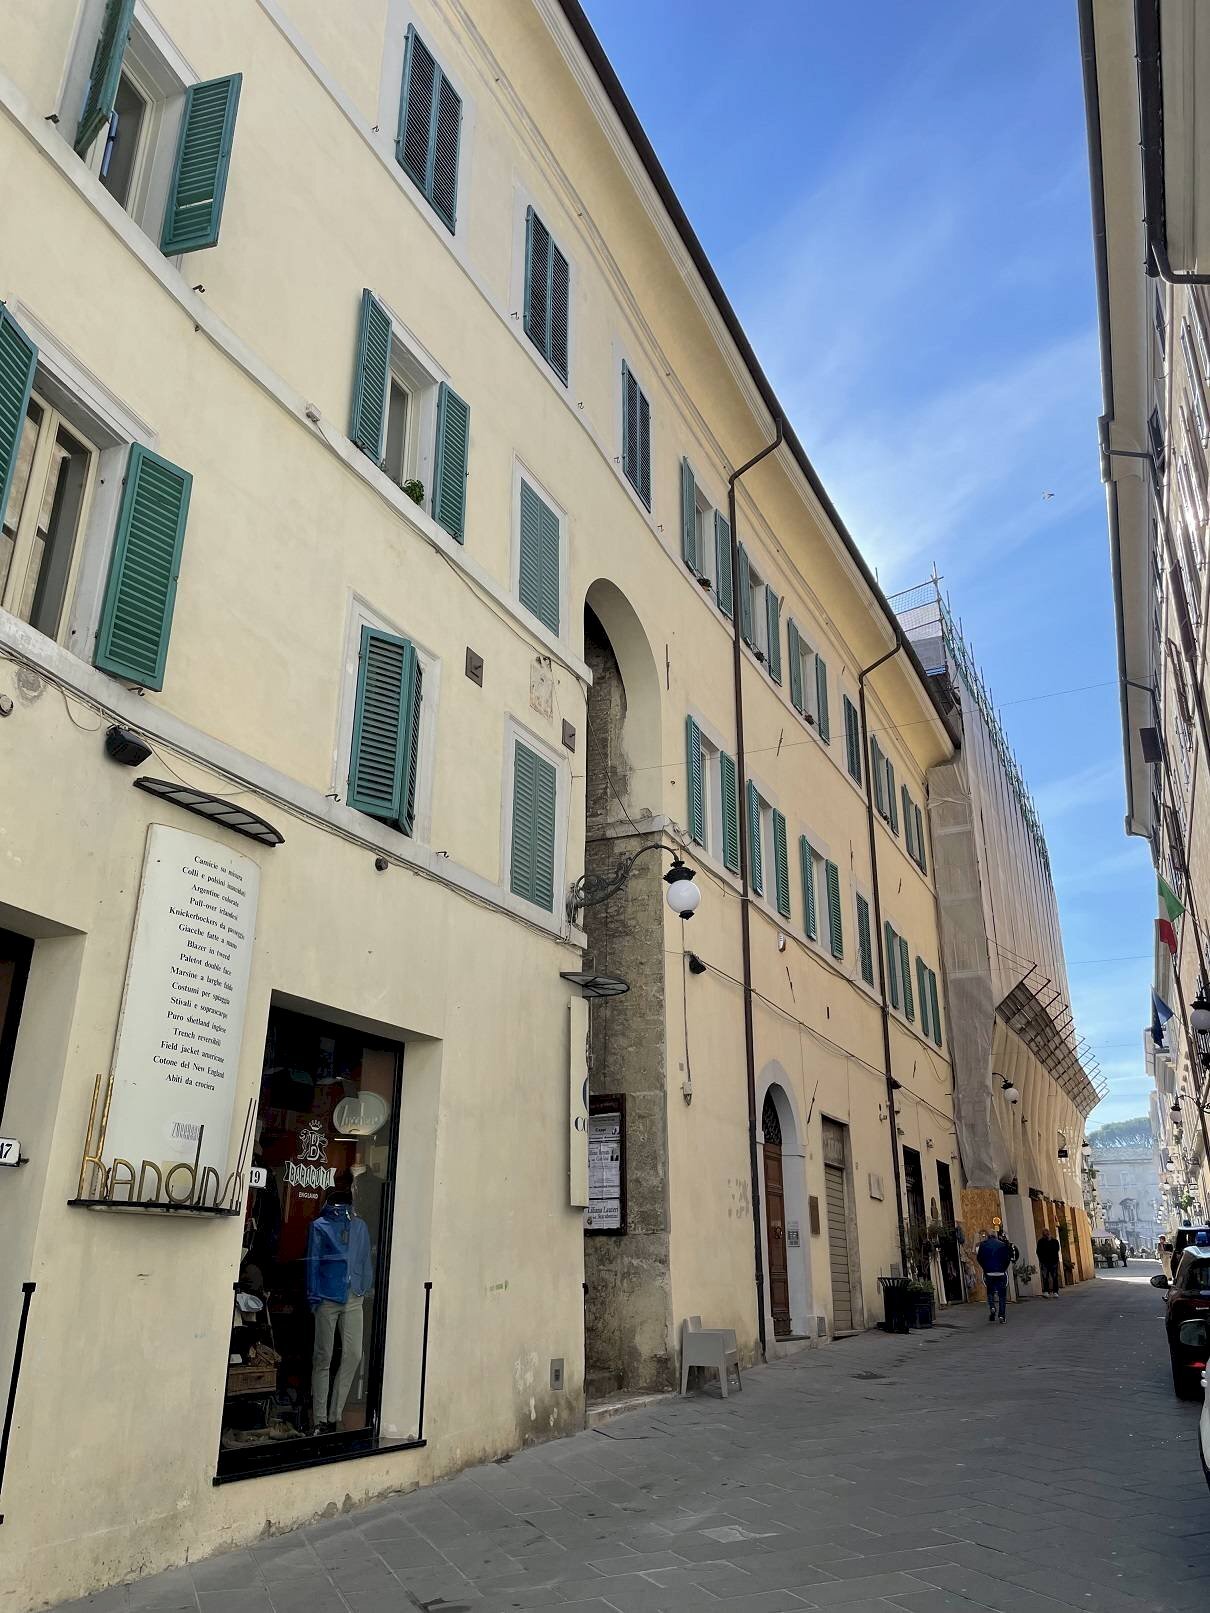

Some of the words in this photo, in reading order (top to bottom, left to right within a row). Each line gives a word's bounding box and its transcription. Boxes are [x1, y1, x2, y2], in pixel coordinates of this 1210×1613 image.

[194, 855, 219, 870] Camicie
[182, 866, 199, 878] Colli
[207, 875, 226, 887] polsini
[192, 884, 220, 899] Argentine
[189, 896, 217, 911] Pull-over
[169, 906, 218, 926] Knickerbockers
[219, 922, 226, 930] da
[178, 923, 205, 937] Giacche
[206, 931, 220, 941] fatte
[187, 939, 207, 952] Blazer
[208, 946, 215, 955] in
[216, 950, 231, 961] tweed
[180, 953, 202, 966] Paletot
[204, 960, 221, 972] double
[222, 966, 232, 976] face
[170, 966, 198, 980] Marsine
[206, 975, 223, 987] larghe
[171, 981, 200, 995] Costumi
[201, 989, 211, 998] per
[170, 996, 192, 1008] Stivali
[167, 1010, 184, 1021] Puro
[186, 1015, 210, 1028] shetland
[173, 1027, 195, 1039] Trench
[160, 1040, 178, 1051] Field
[180, 1044, 200, 1056] jacket
[152, 1055, 178, 1067] Cotone
[180, 1060, 191, 1069] del
[207, 1066, 225, 1079] England
[165, 1073, 183, 1084] Abiti
[184, 1077, 193, 1086] da
[194, 1080, 215, 1091] crociera
[0, 1142, 13, 1159] 17
[298, 1191, 319, 1200] ENGLAND
